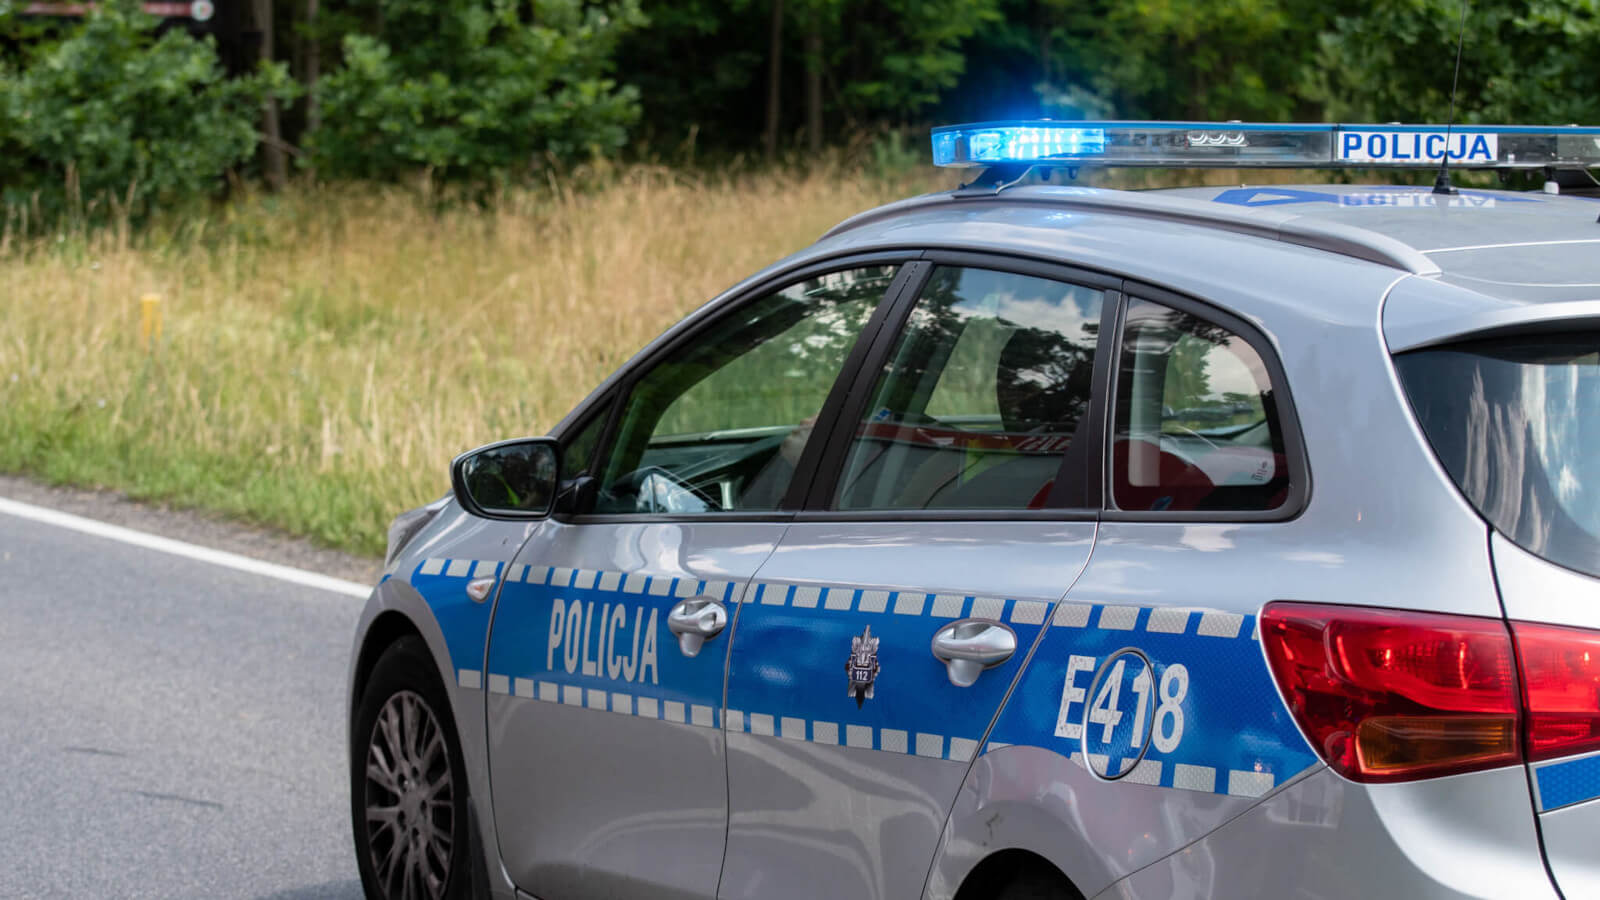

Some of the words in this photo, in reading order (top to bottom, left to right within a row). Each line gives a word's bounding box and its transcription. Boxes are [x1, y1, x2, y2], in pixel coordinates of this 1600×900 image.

[1343, 133, 1492, 159] POLICJA
[547, 598, 659, 685] POLICJA
[856, 670, 869, 681] 112
[1054, 654, 1190, 754] E418
